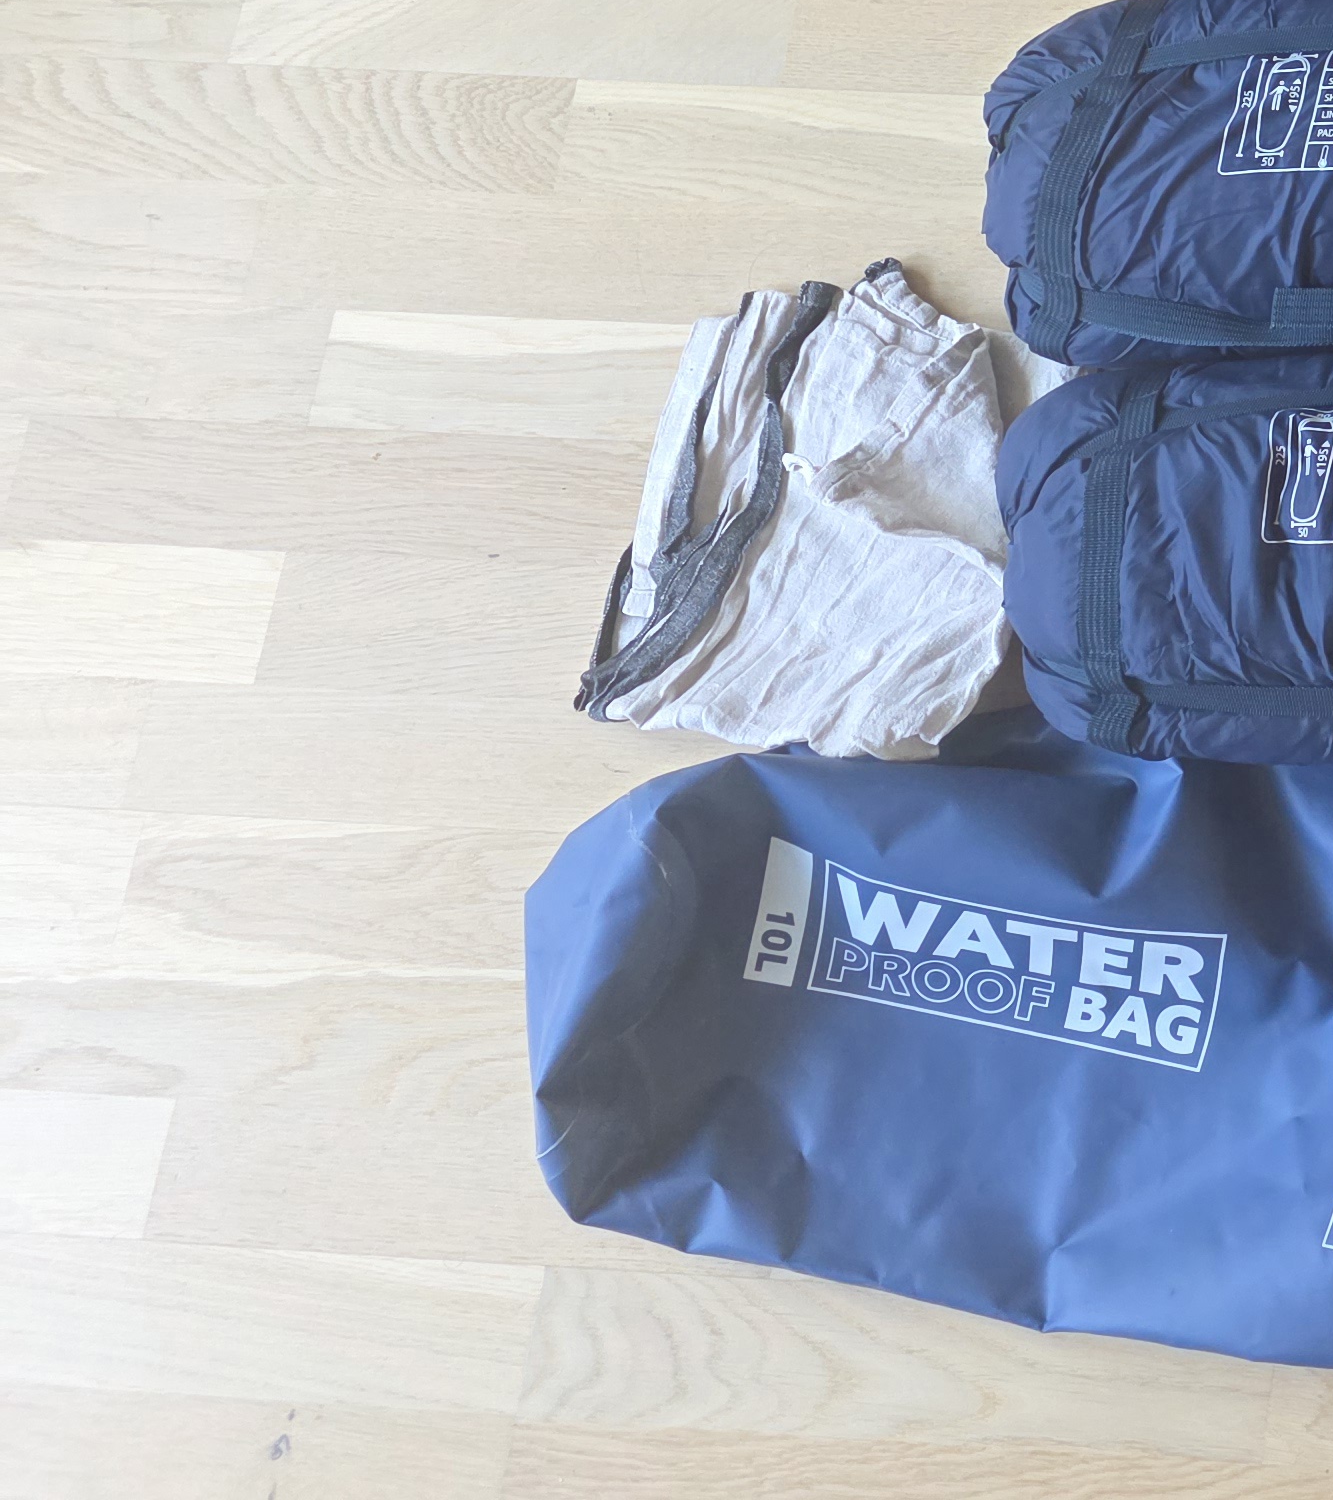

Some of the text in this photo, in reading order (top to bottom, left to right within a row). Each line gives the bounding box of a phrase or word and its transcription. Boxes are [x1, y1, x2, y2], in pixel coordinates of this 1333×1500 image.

[1241, 90, 1254, 108] 225
[1288, 85, 1300, 104] 195
[1260, 157, 1274, 167] 50
[1275, 445, 1286, 466] 225
[1316, 448, 1328, 469] 195
[1298, 527, 1308, 538] 50
[754, 911, 796, 973] 10L
[836, 872, 1205, 1003] WATER
[826, 937, 1203, 1055] PROOF BAG
